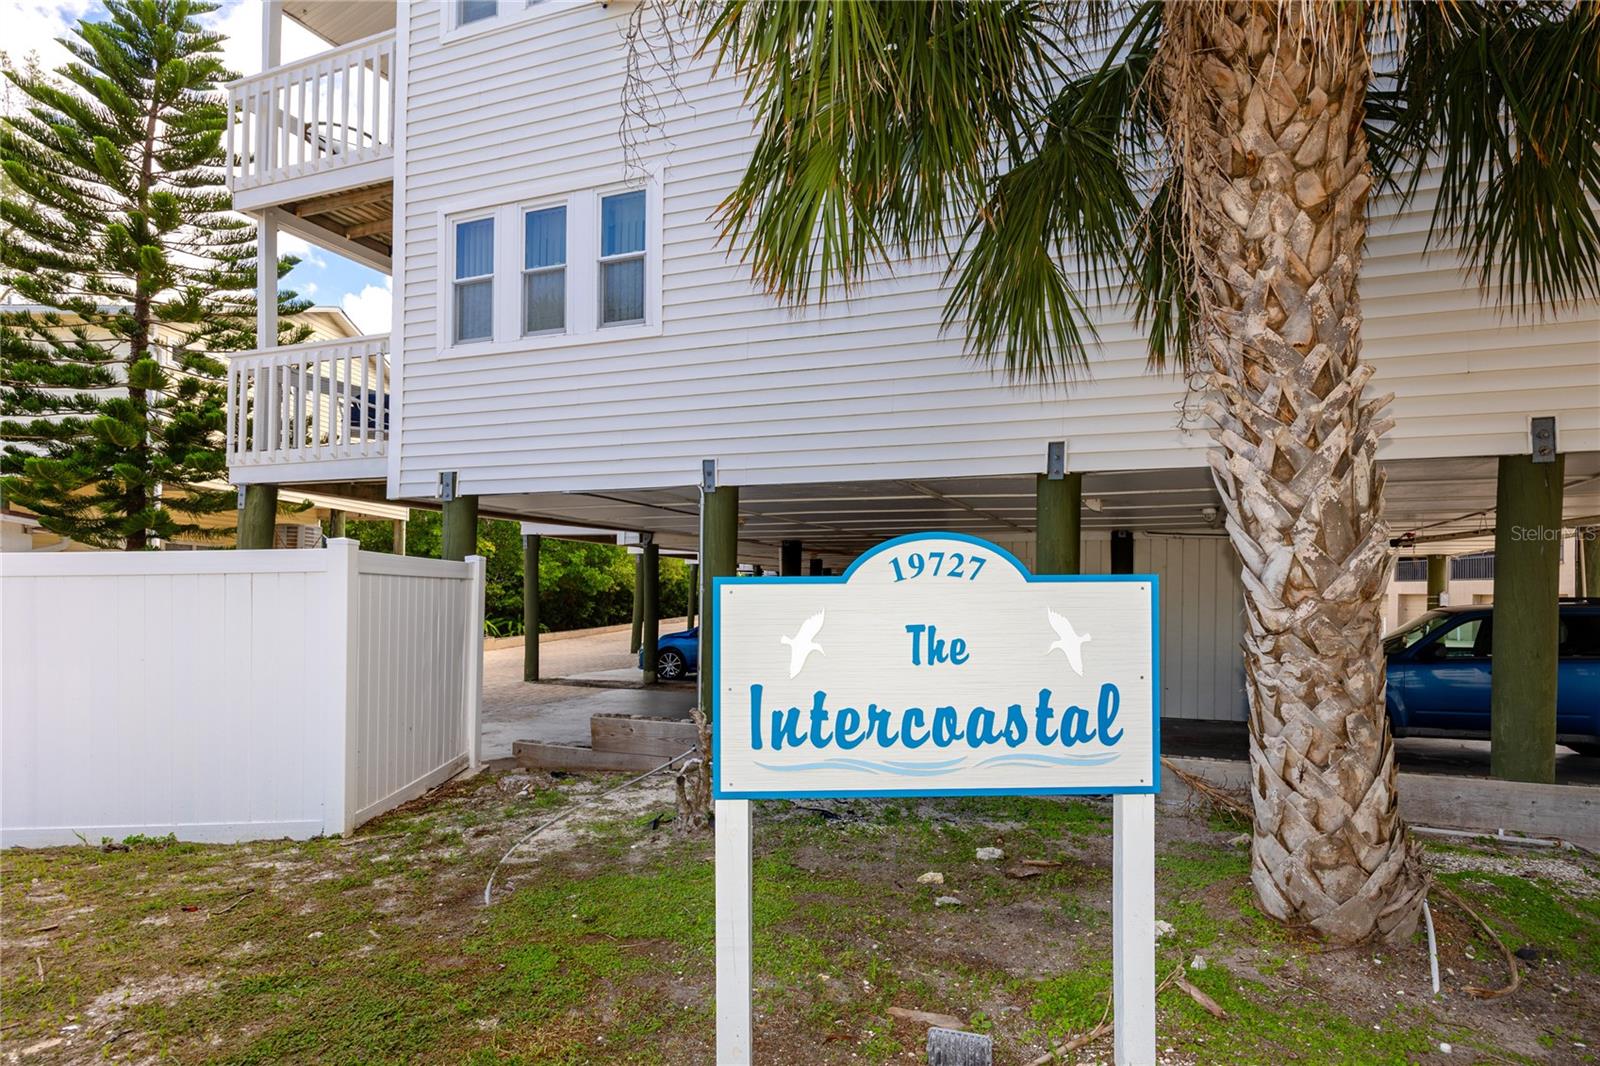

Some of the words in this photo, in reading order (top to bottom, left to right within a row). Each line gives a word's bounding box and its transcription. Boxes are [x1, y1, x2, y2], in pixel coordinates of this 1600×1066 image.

[889, 552, 986, 582] 19727
[905, 624, 969, 665] The
[750, 683, 1123, 750] Intercoastal
